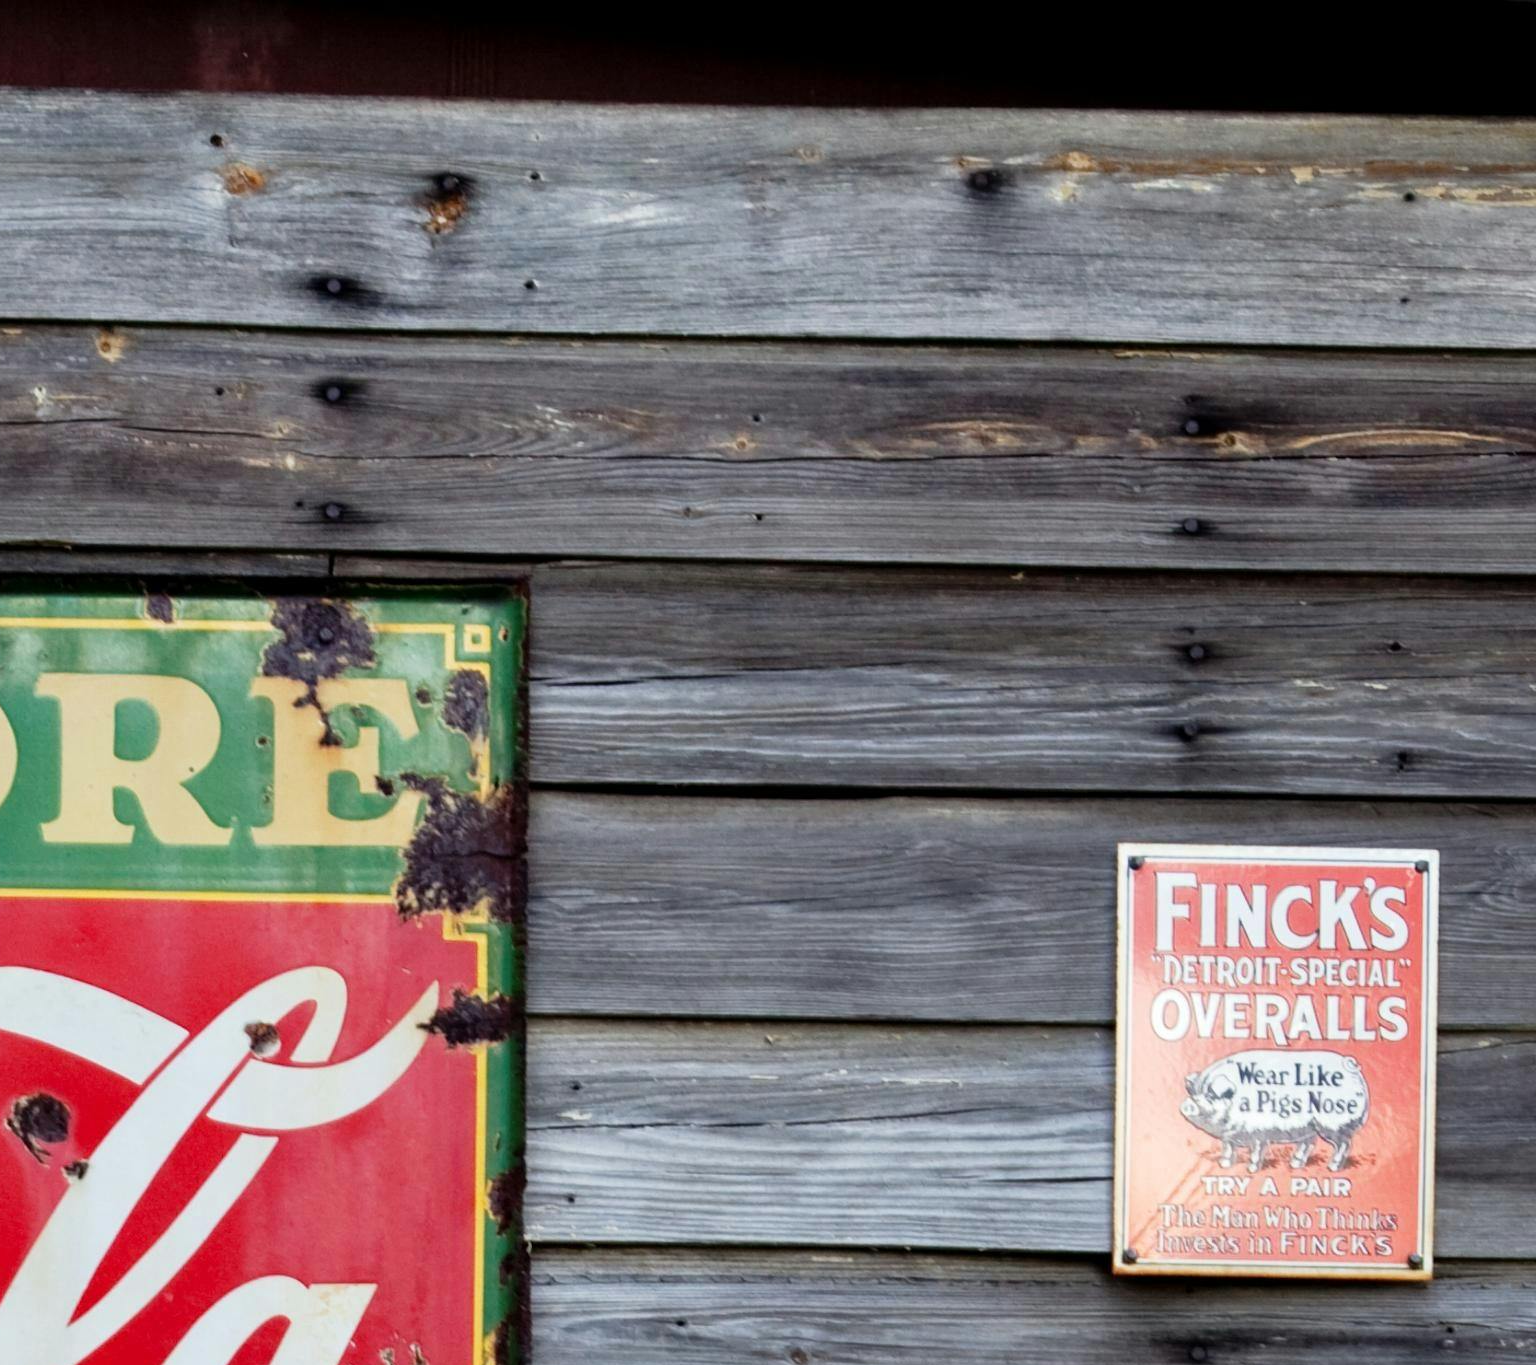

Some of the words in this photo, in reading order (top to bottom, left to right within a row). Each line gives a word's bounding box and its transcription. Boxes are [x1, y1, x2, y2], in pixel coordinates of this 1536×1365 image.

[1154, 870, 1409, 952] FINCK'S
[1150, 988, 1410, 1047] OVERALLS
[1294, 1062, 1344, 1087] Like
[1239, 1096, 1251, 1113] a
[1256, 1090, 1302, 1119] Pigs
[1201, 1175, 1252, 1196] TRY
[1259, 1176, 1279, 1196] A
[1289, 1177, 1353, 1198] PAIR
[1159, 1203, 1207, 1229] The
[1211, 1205, 1260, 1230] Man
[1263, 1205, 1314, 1231] Who
[1314, 1207, 1399, 1231] Thinks
[1155, 1229, 1240, 1255] Invests
[1248, 1231, 1274, 1255] in
[1278, 1231, 1394, 1257] FINCK'S
